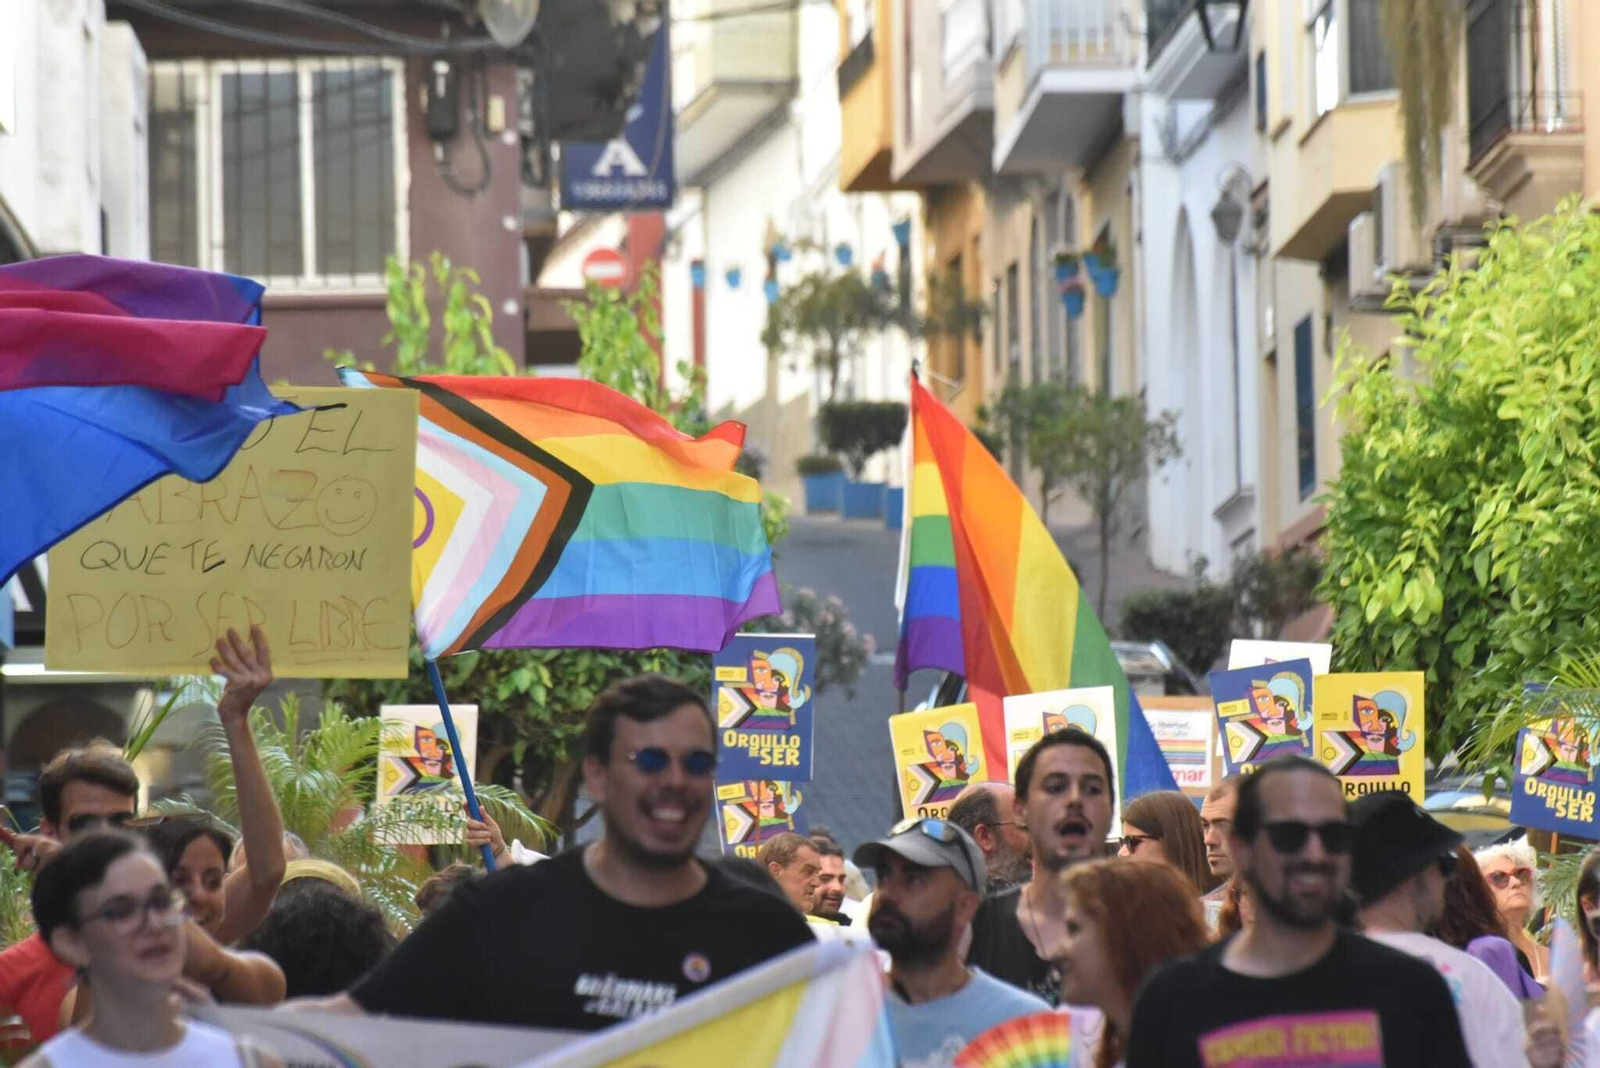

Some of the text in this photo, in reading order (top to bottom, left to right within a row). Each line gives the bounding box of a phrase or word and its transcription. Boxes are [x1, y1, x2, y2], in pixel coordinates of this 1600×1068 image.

[80, 540, 367, 575] QUE TE NEGARON
[66, 592, 175, 652] POR
[287, 596, 404, 651] LIBRE
[760, 747, 801, 767] SER
[1344, 781, 1412, 796] RGULLO
[1555, 800, 1595, 823] SER
